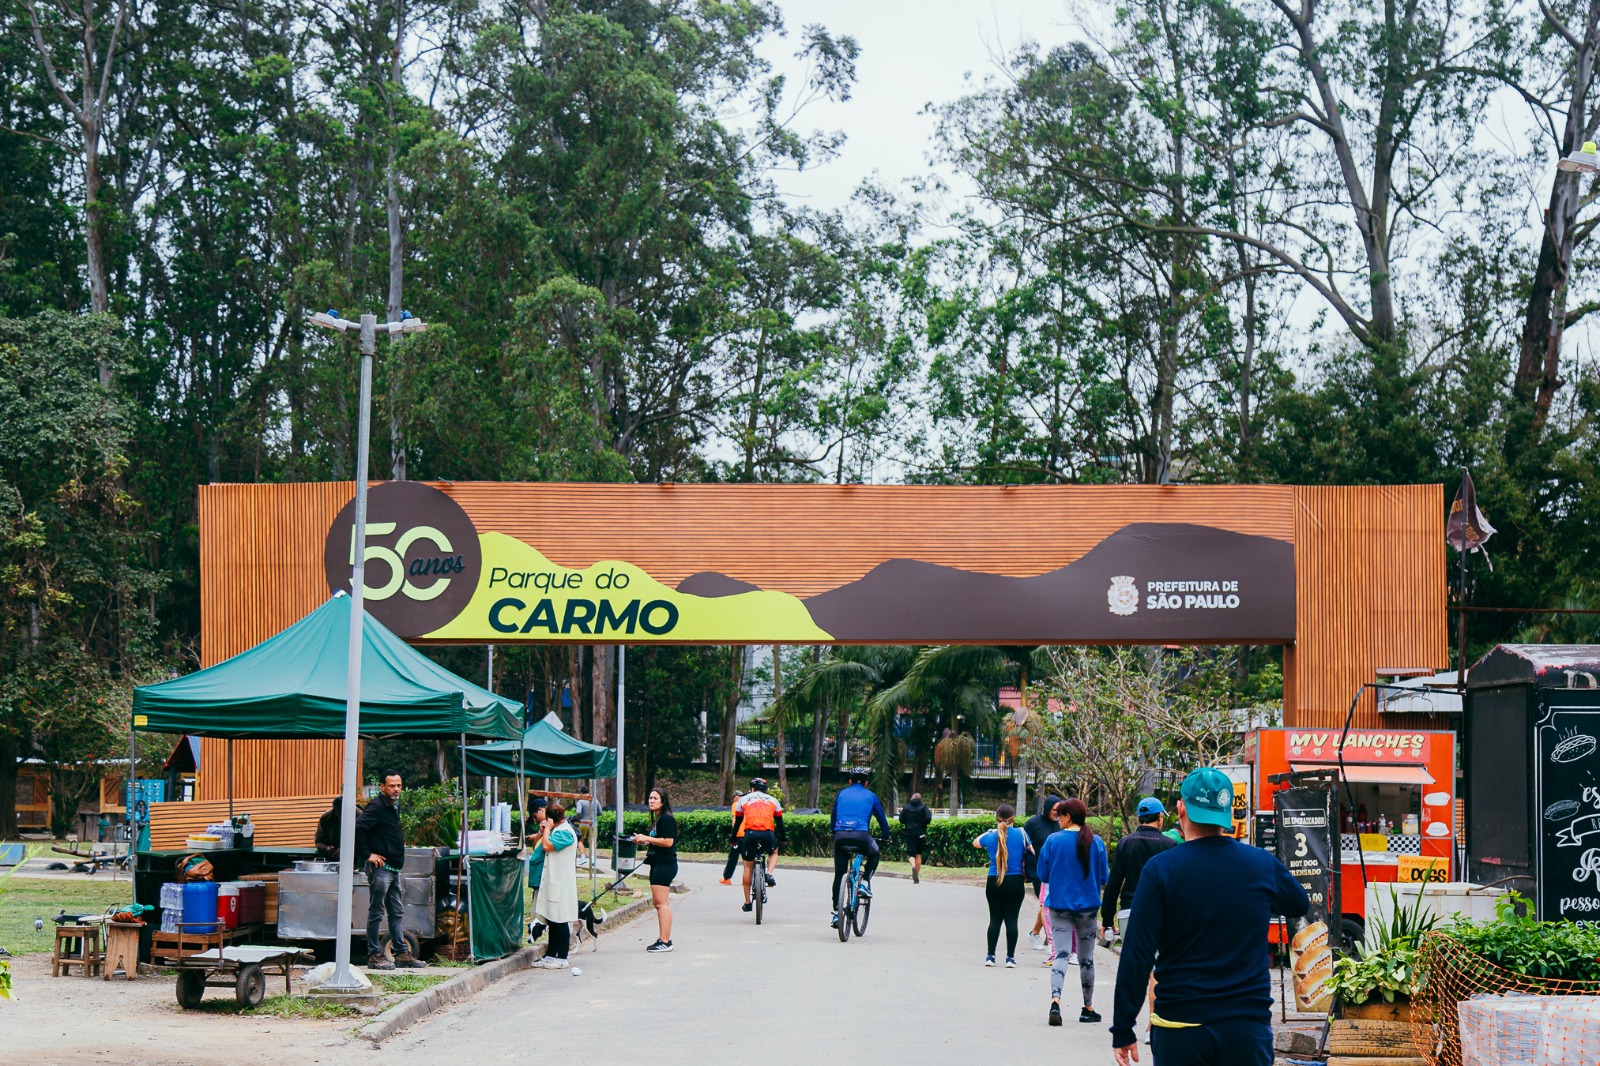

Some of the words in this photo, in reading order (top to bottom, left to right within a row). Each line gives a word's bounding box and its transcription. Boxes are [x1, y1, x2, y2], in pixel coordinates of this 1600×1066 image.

[349, 522, 454, 601] 50
[409, 553, 465, 577] anos
[489, 567, 583, 594] Parque
[595, 568, 630, 589] do
[1147, 581, 1219, 592] PREFEITURA
[1222, 581, 1239, 592] DE
[1147, 593, 1182, 609] SÃO
[1185, 594, 1240, 609] PAULO
[488, 598, 679, 635] CARMO
[1290, 733, 1329, 747] MV
[1332, 733, 1425, 749] LANCHES
[1294, 832, 1308, 857] 3
[1290, 860, 1303, 868] HOT
[1289, 868, 1322, 877] RENSADO
[1411, 868, 1447, 883] DOGS
